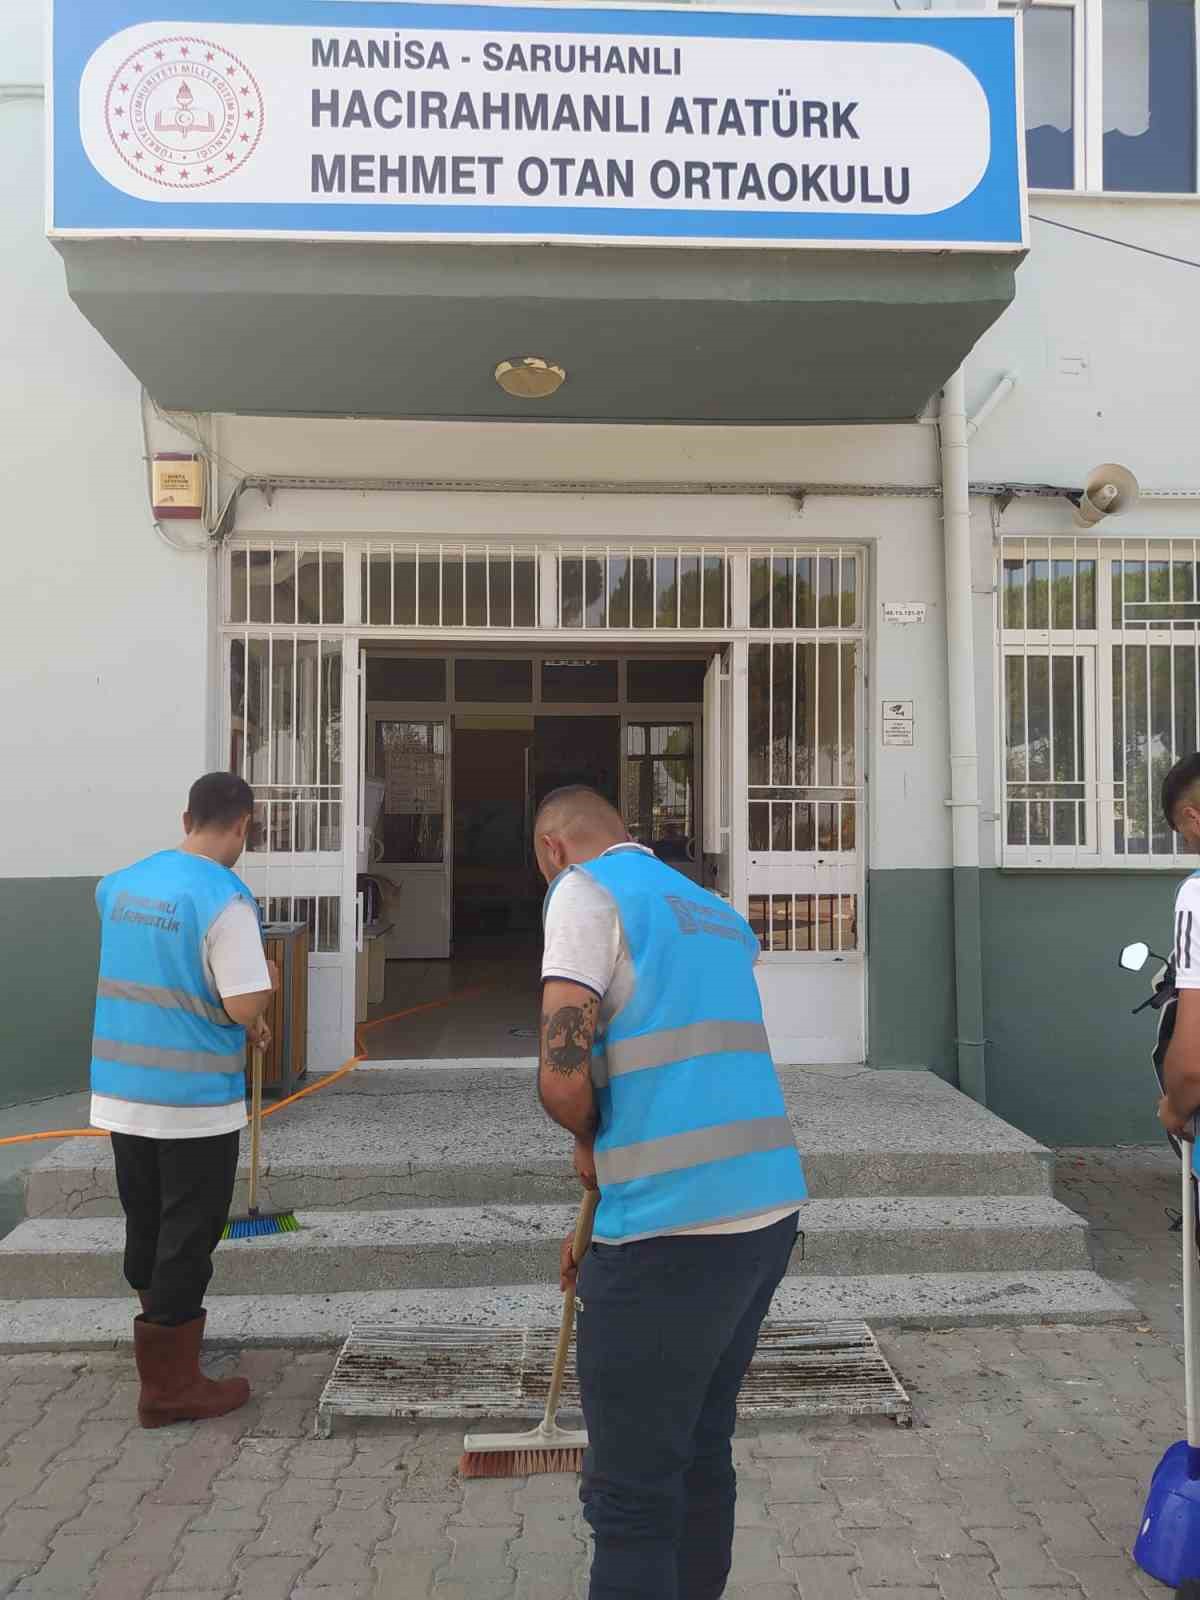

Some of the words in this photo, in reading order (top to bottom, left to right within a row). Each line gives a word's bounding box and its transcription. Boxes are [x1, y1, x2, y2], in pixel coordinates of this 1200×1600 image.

[312, 32, 450, 70] MANİSA
[483, 42, 681, 75] SARUHANLI
[311, 89, 650, 133] HACIRAHMANLI
[665, 88, 860, 140] ATATÜRK
[311, 154, 504, 195] MEHMET
[517, 157, 634, 199] OTAN
[650, 160, 910, 205] ORTAOKULU
